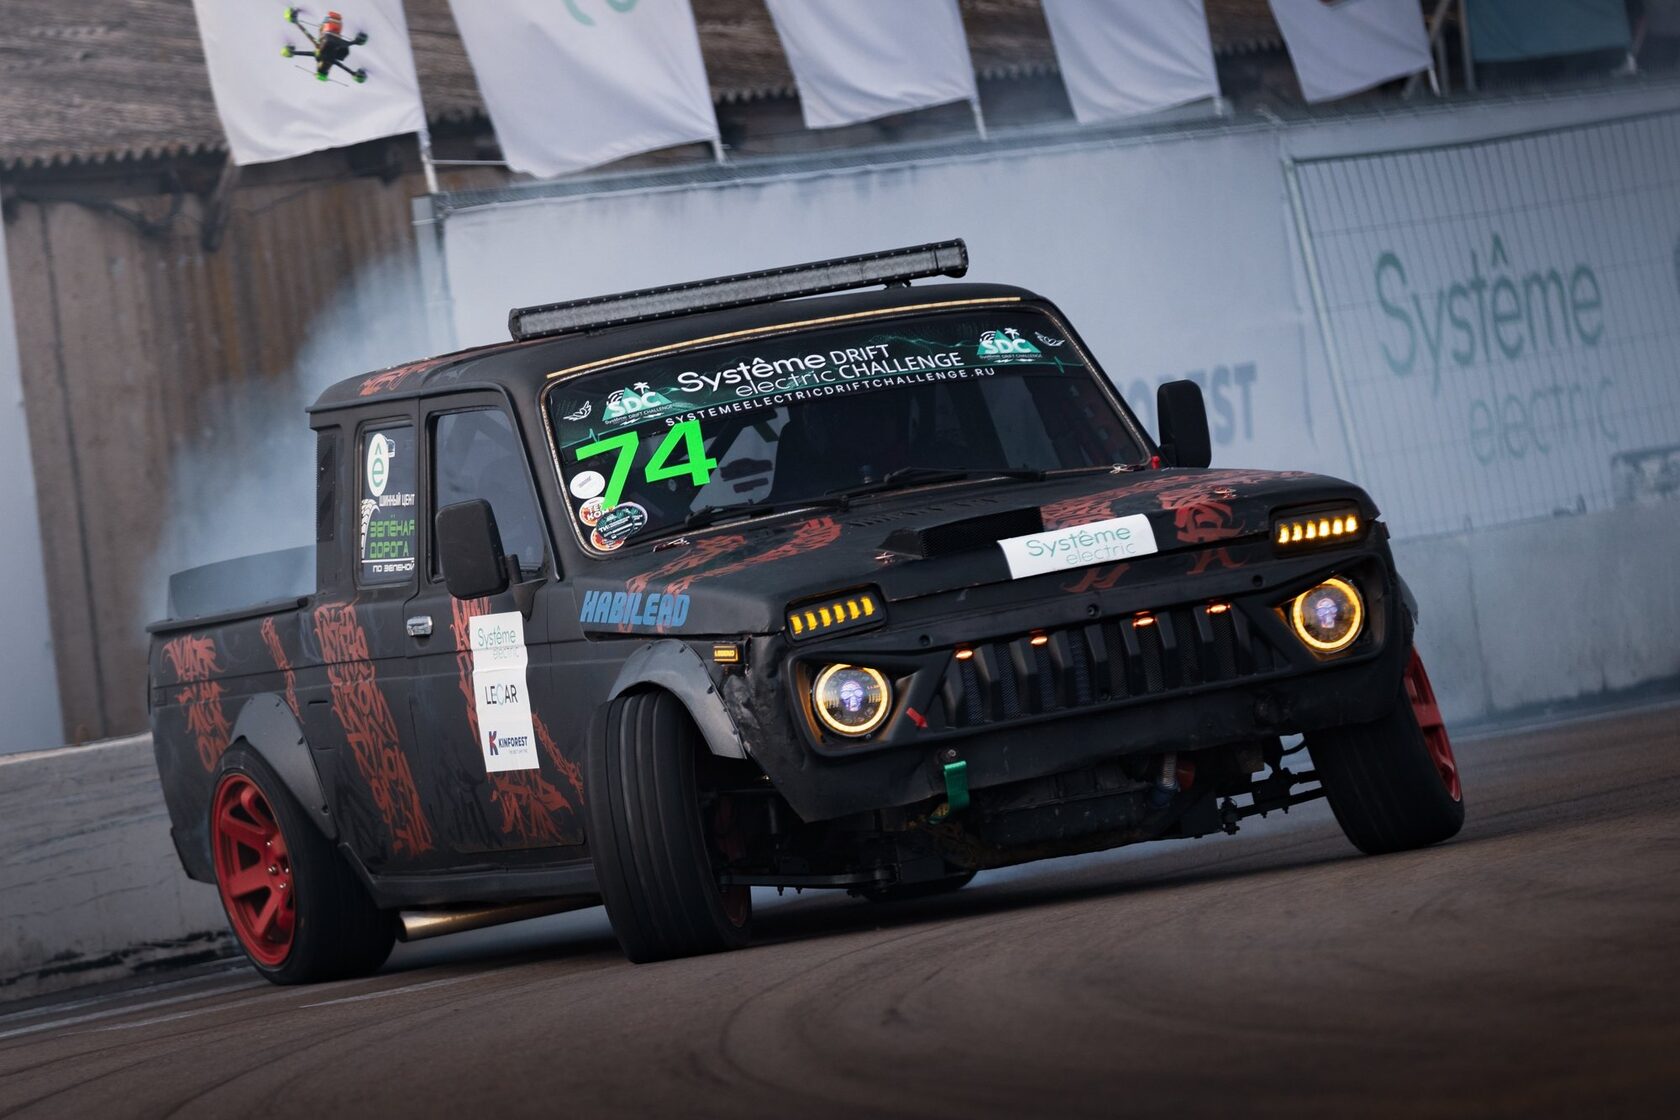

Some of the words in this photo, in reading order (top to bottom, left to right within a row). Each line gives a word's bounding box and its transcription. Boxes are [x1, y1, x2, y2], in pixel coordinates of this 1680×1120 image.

[1374, 232, 1604, 397] Système
[981, 338, 1031, 354] SDC
[677, 354, 826, 392] Système
[830, 344, 889, 365] DRIFT
[736, 370, 836, 397] electric
[838, 352, 965, 379] CHALLENGE
[608, 391, 661, 418] SDC
[665, 367, 995, 427] SYSTEMEELECTRICDRIFTCHALLENGE.RU
[575, 418, 718, 511] 74
[369, 541, 409, 559] ДОРОГА
[1026, 527, 1131, 557] Système
[1066, 542, 1136, 565] electric
[579, 590, 691, 628] HABILEAD
[477, 625, 516, 649] Système
[485, 683, 518, 706] LECAR
[498, 735, 528, 749] KINFOREST
